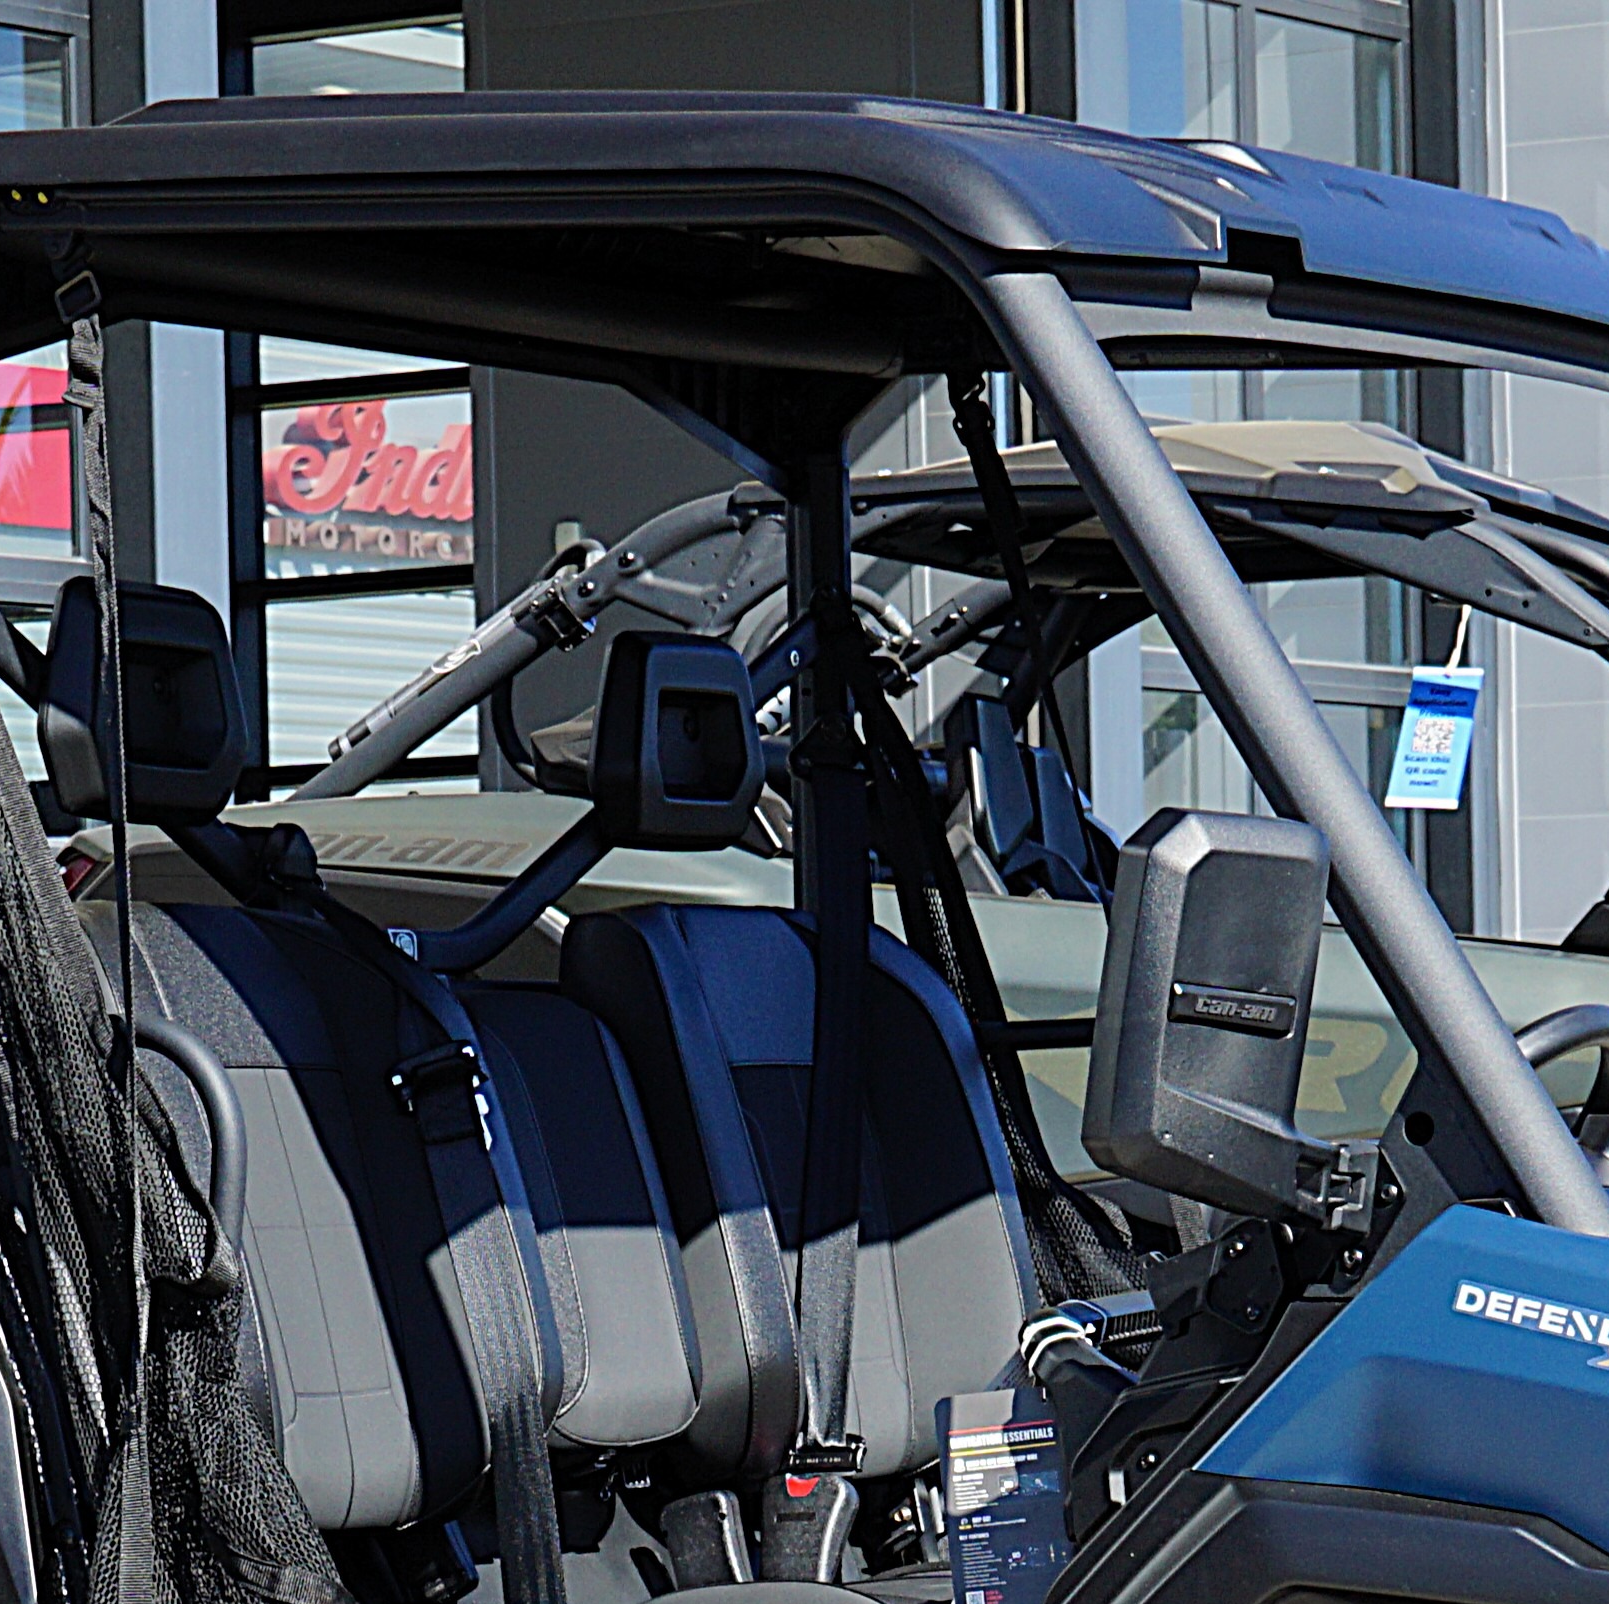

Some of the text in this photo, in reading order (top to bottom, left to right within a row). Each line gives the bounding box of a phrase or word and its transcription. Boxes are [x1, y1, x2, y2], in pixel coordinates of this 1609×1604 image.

[311, 834, 532, 869] an-am
[1195, 998, 1277, 1022] can-am
[1003, 1426, 1054, 1443] ESSENTIALS
